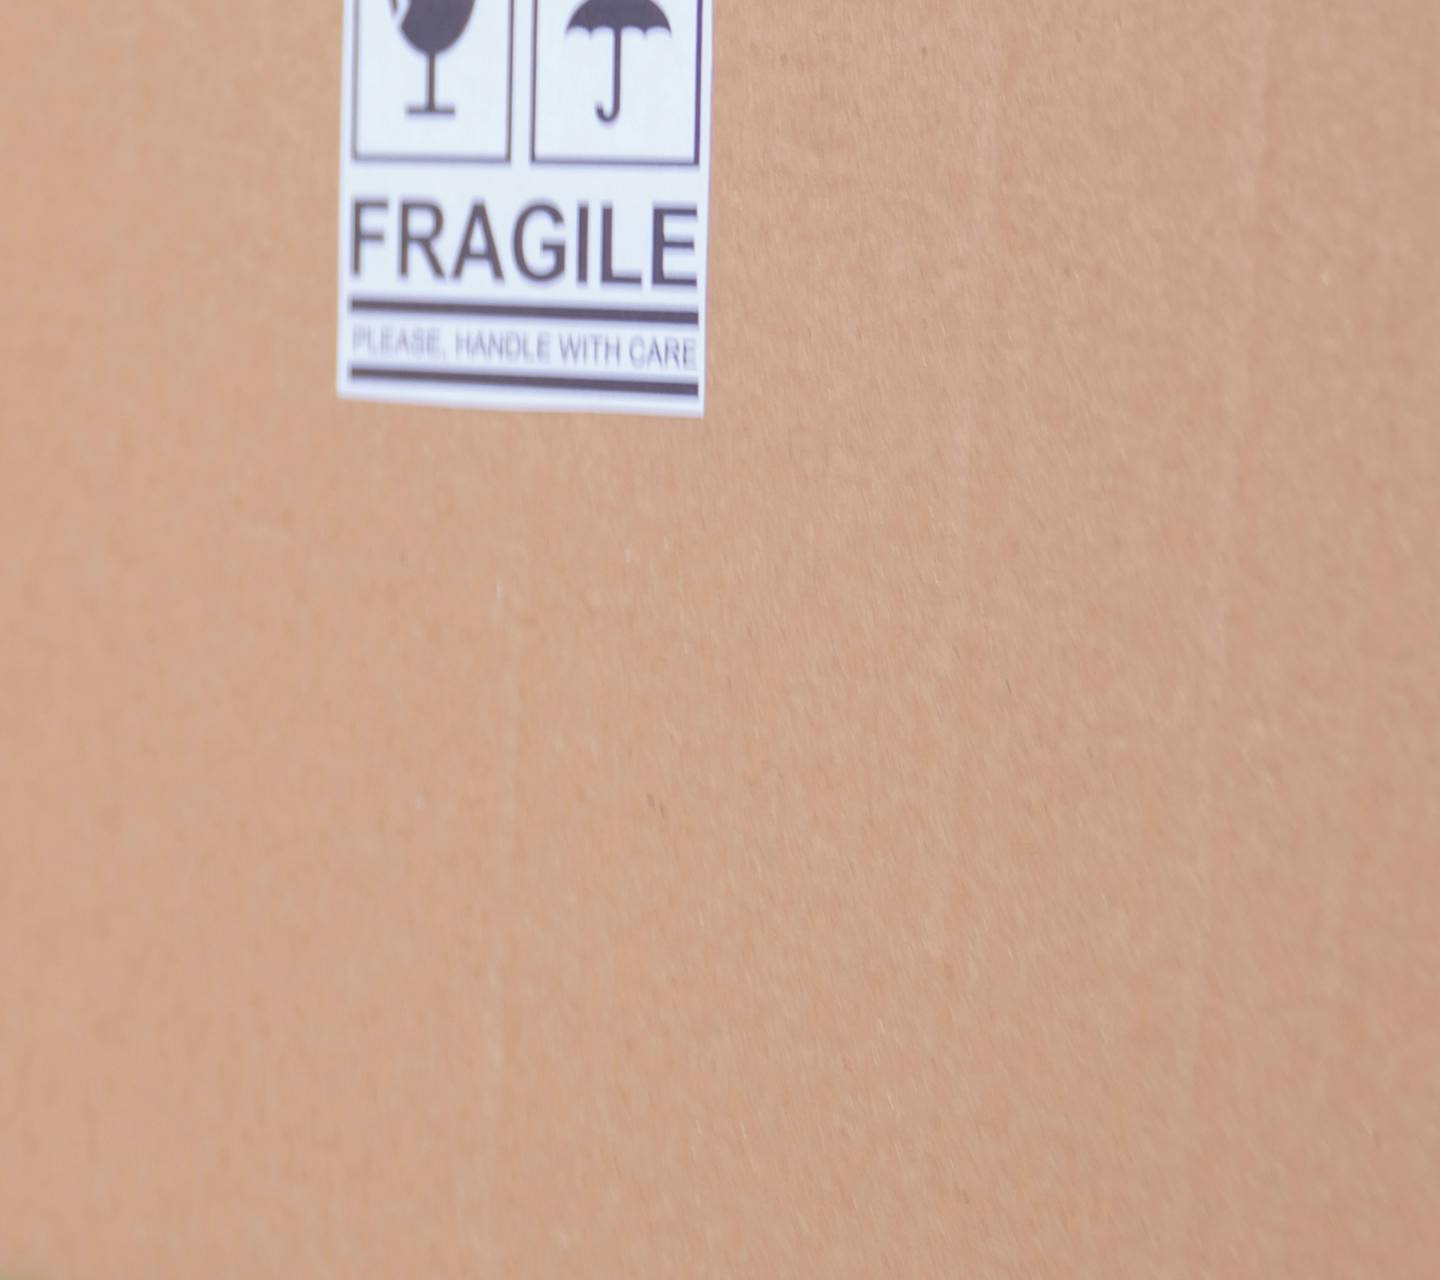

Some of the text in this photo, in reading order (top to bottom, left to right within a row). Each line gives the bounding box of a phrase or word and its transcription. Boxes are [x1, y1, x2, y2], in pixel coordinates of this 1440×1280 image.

[351, 198, 698, 287] FRAGILE
[455, 331, 550, 364] HANDLE
[559, 336, 621, 367] WITH
[629, 338, 696, 371] CARE
